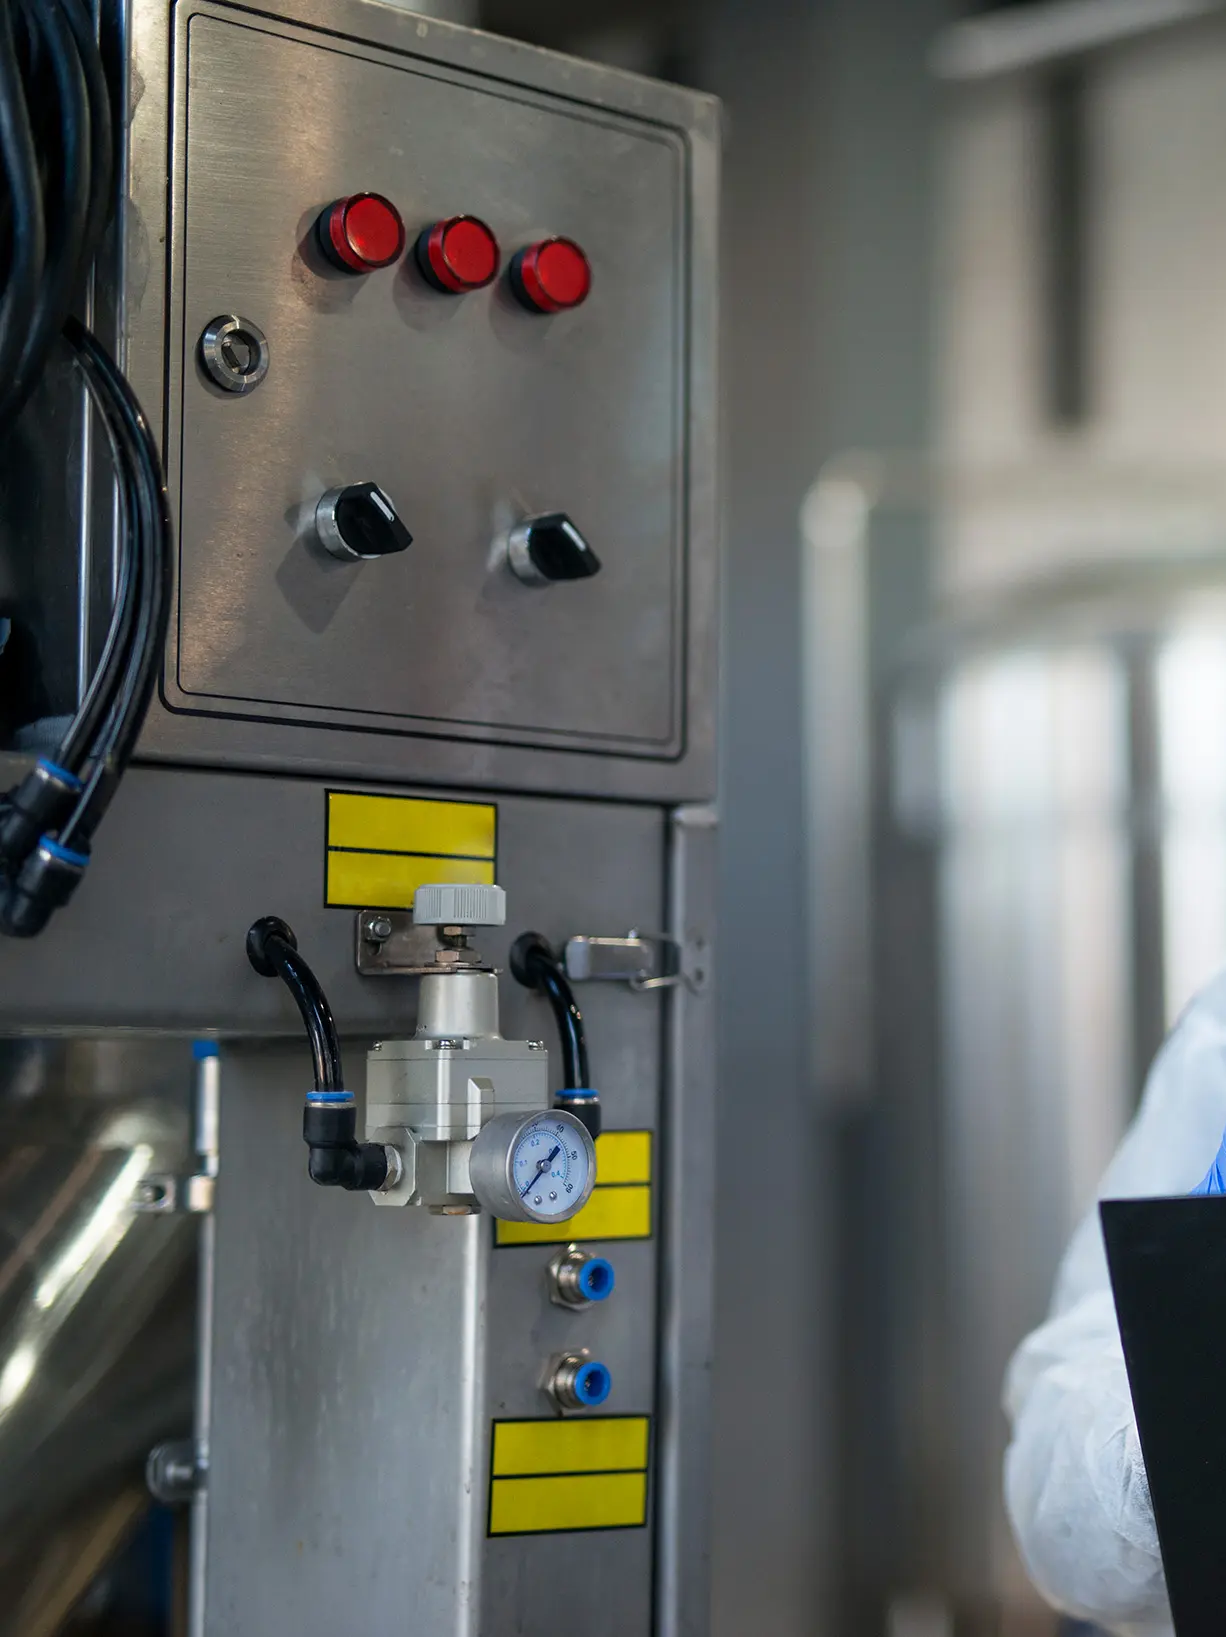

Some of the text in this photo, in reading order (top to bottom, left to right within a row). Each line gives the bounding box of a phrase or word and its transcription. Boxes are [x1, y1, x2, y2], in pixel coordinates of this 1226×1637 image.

[531, 1139, 540, 1147] 0.2
[570, 1150, 578, 1161] 50
[551, 1170, 560, 1178] 0.4
[565, 1184, 574, 1194] 60
